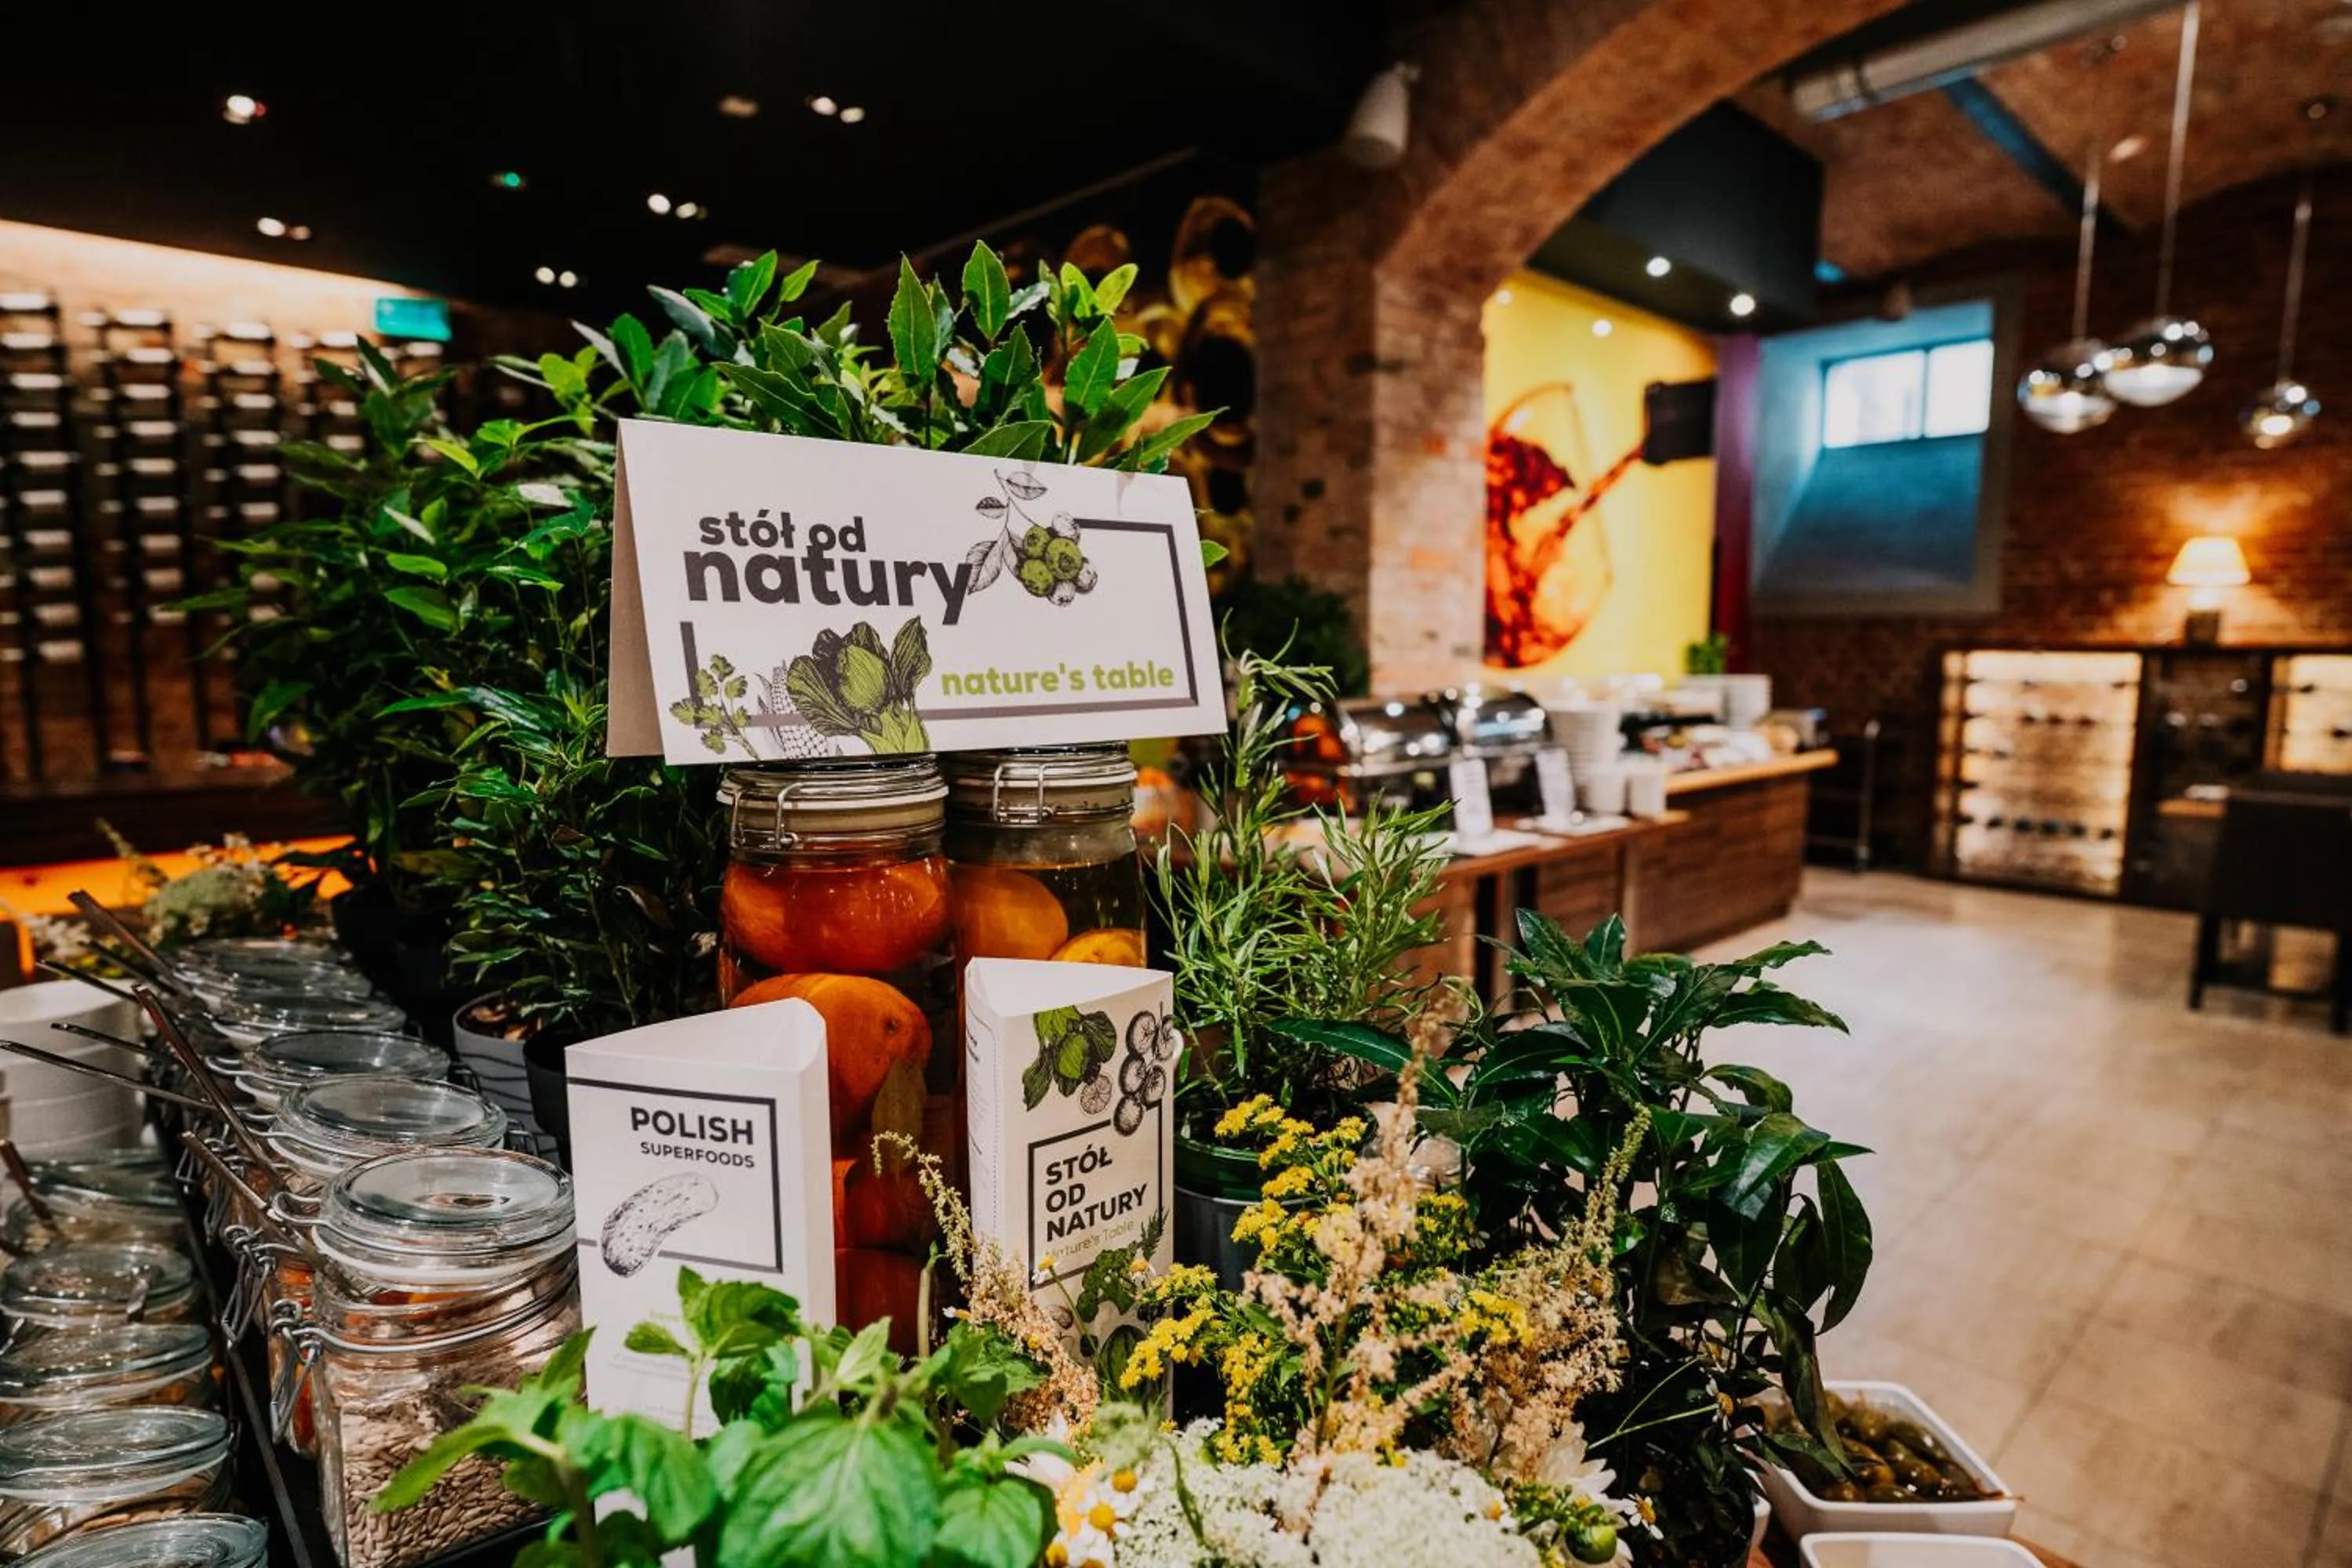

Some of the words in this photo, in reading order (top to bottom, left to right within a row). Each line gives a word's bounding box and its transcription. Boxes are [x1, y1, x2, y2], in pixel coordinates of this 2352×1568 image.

[699, 509, 795, 549] stół
[808, 516, 866, 552] od
[684, 544, 972, 626] natury
[941, 662, 1086, 695] nature's
[1092, 660, 1174, 690] table
[631, 1107, 753, 1145] POLISH
[641, 1142, 755, 1168] SUPERFOODS
[1046, 1144, 1112, 1185] STÓŁ
[1046, 1183, 1086, 1213] OD
[1047, 1183, 1147, 1242] NATURY
